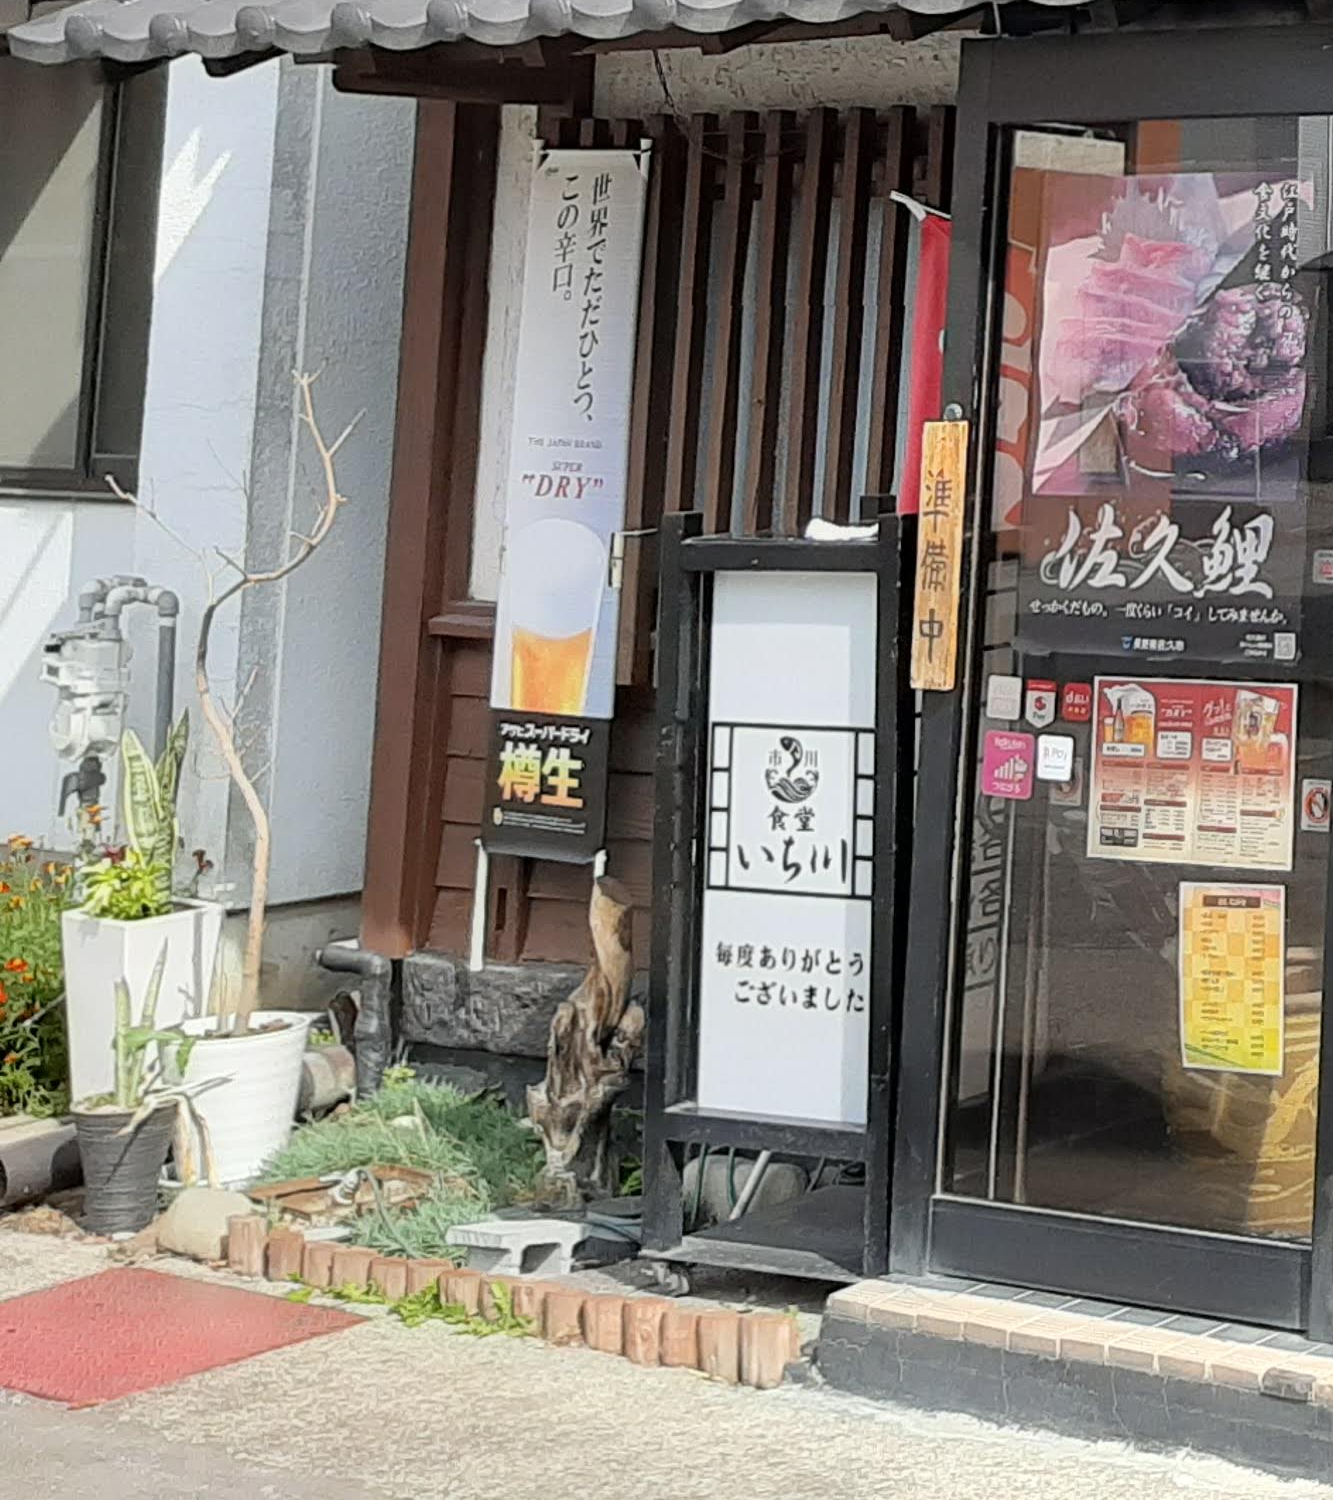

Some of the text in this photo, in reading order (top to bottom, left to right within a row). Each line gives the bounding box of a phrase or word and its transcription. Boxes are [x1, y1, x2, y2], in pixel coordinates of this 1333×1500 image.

[552, 175, 580, 301] この辛口。
[918, 468, 953, 665] 準備中
[1056, 504, 1275, 599] 佐久鯉
[496, 740, 585, 809] 樽生
[767, 804, 816, 832] 食堂
[736, 835, 848, 885] いち川
[716, 941, 864, 977] 毎度ありがとう
[735, 980, 865, 1013] ございました
